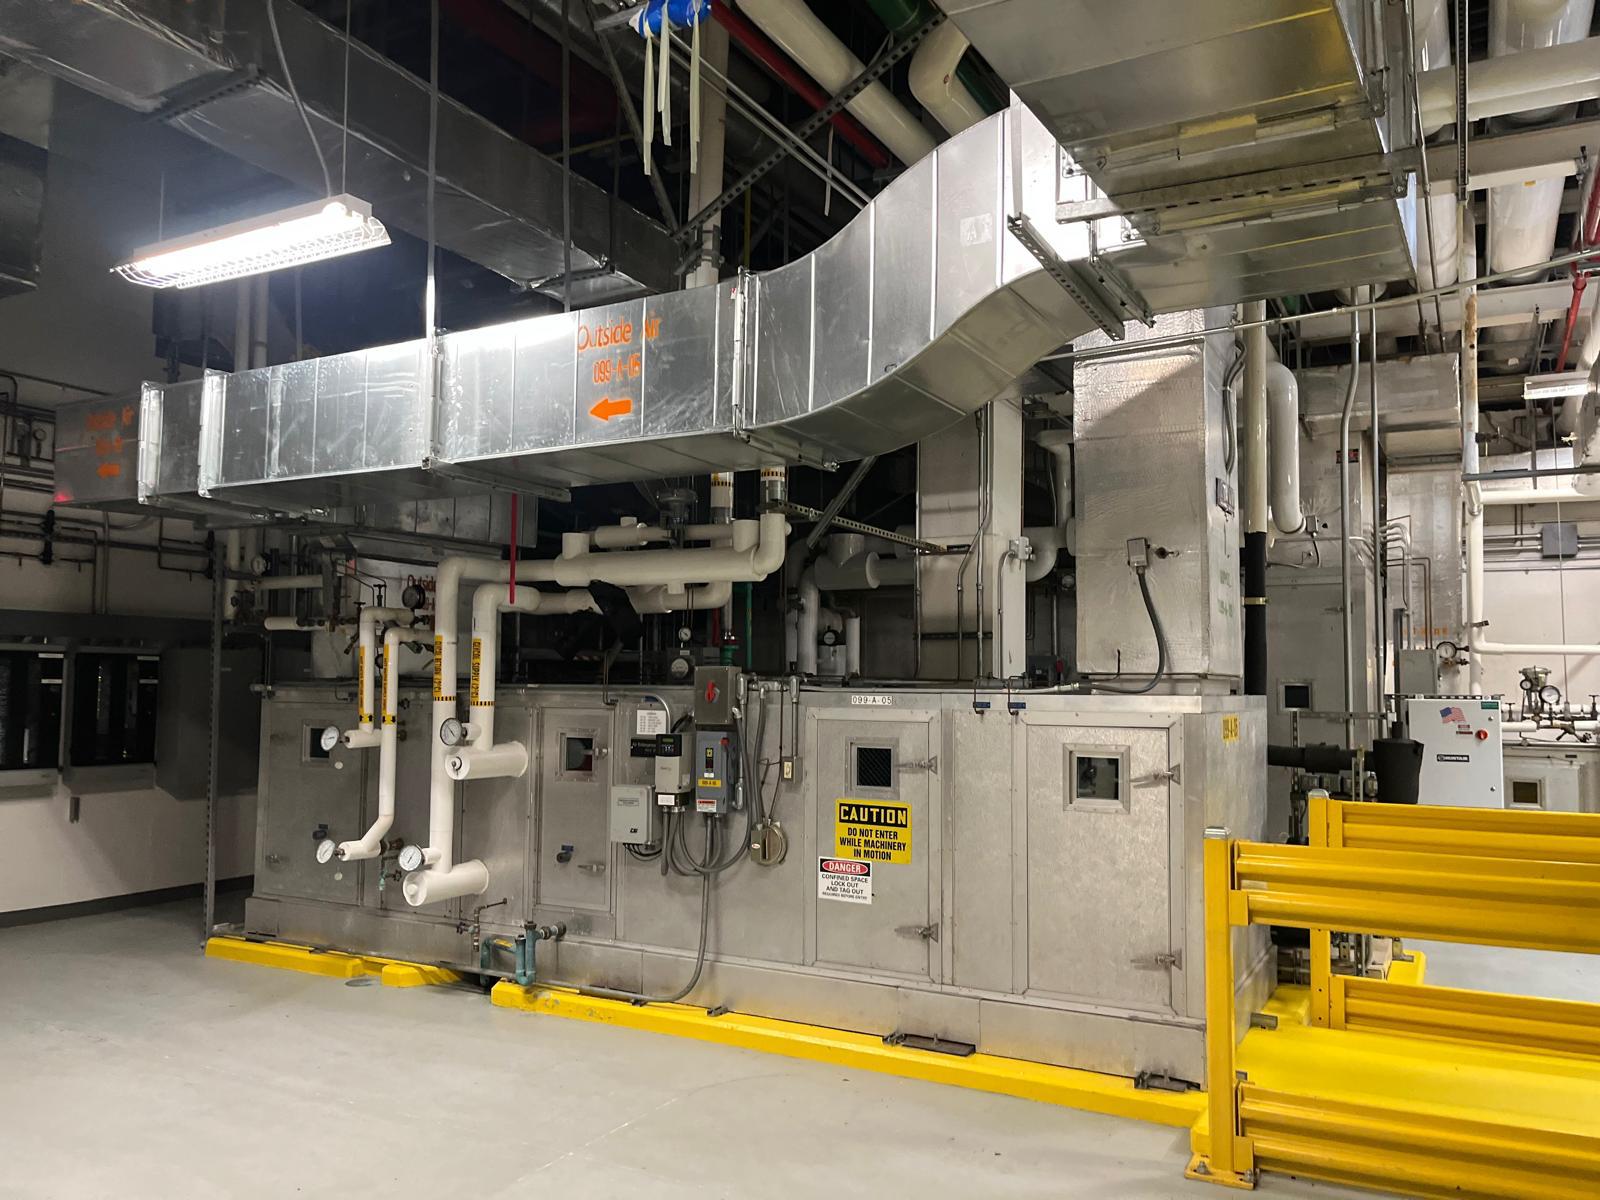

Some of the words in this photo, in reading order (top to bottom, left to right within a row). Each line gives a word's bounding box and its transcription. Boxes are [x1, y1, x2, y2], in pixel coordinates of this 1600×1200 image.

[577, 316, 632, 350] Outside
[472, 641, 481, 660] GLYCOL
[471, 662, 480, 681] SUPPLY
[852, 696, 892, 704] 099-A-05
[840, 805, 907, 825] CAUTION
[847, 827, 858, 837] DO
[859, 828, 873, 838] NOT
[875, 830, 898, 840] ENTER
[840, 837, 862, 848] WHILE
[863, 839, 907, 852] MACHINERY
[853, 849, 861, 858] IN
[863, 849, 892, 861] MOTION
[828, 861, 861, 874] DANGER
[821, 873, 850, 882] CONFINED
[850, 876, 869, 884] SPACE
